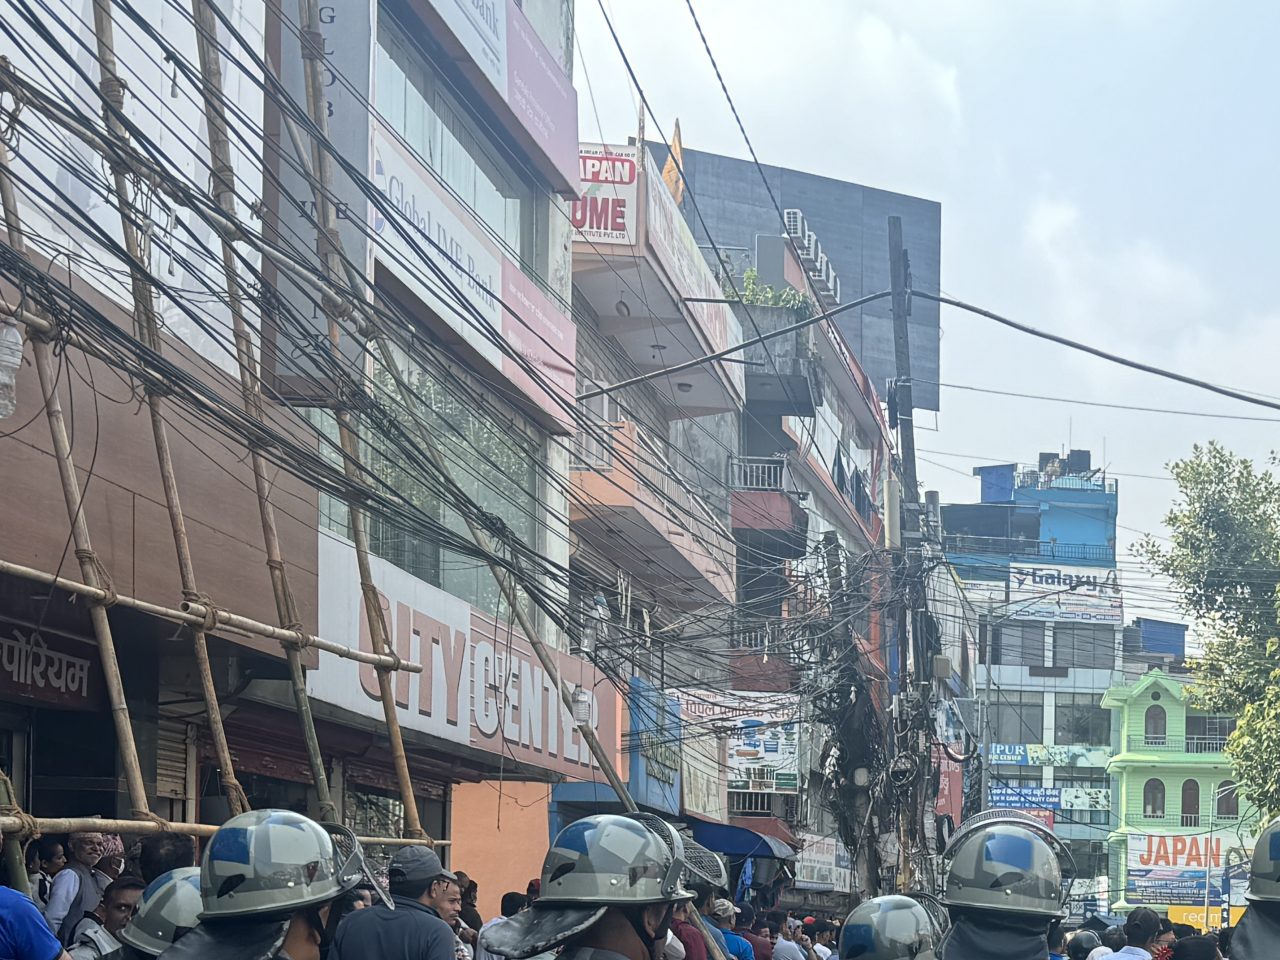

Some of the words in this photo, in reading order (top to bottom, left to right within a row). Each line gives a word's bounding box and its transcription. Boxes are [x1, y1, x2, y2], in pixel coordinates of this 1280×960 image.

[571, 195, 627, 232] UME
[388, 175, 432, 245] Global
[466, 254, 497, 313] Bank
[1032, 568, 1098, 592] Galaxy
[0, 629, 91, 697] पोरियम
[359, 589, 468, 728] CITY
[474, 640, 602, 769] CENTER
[1139, 834, 1221, 868] JAPAN
